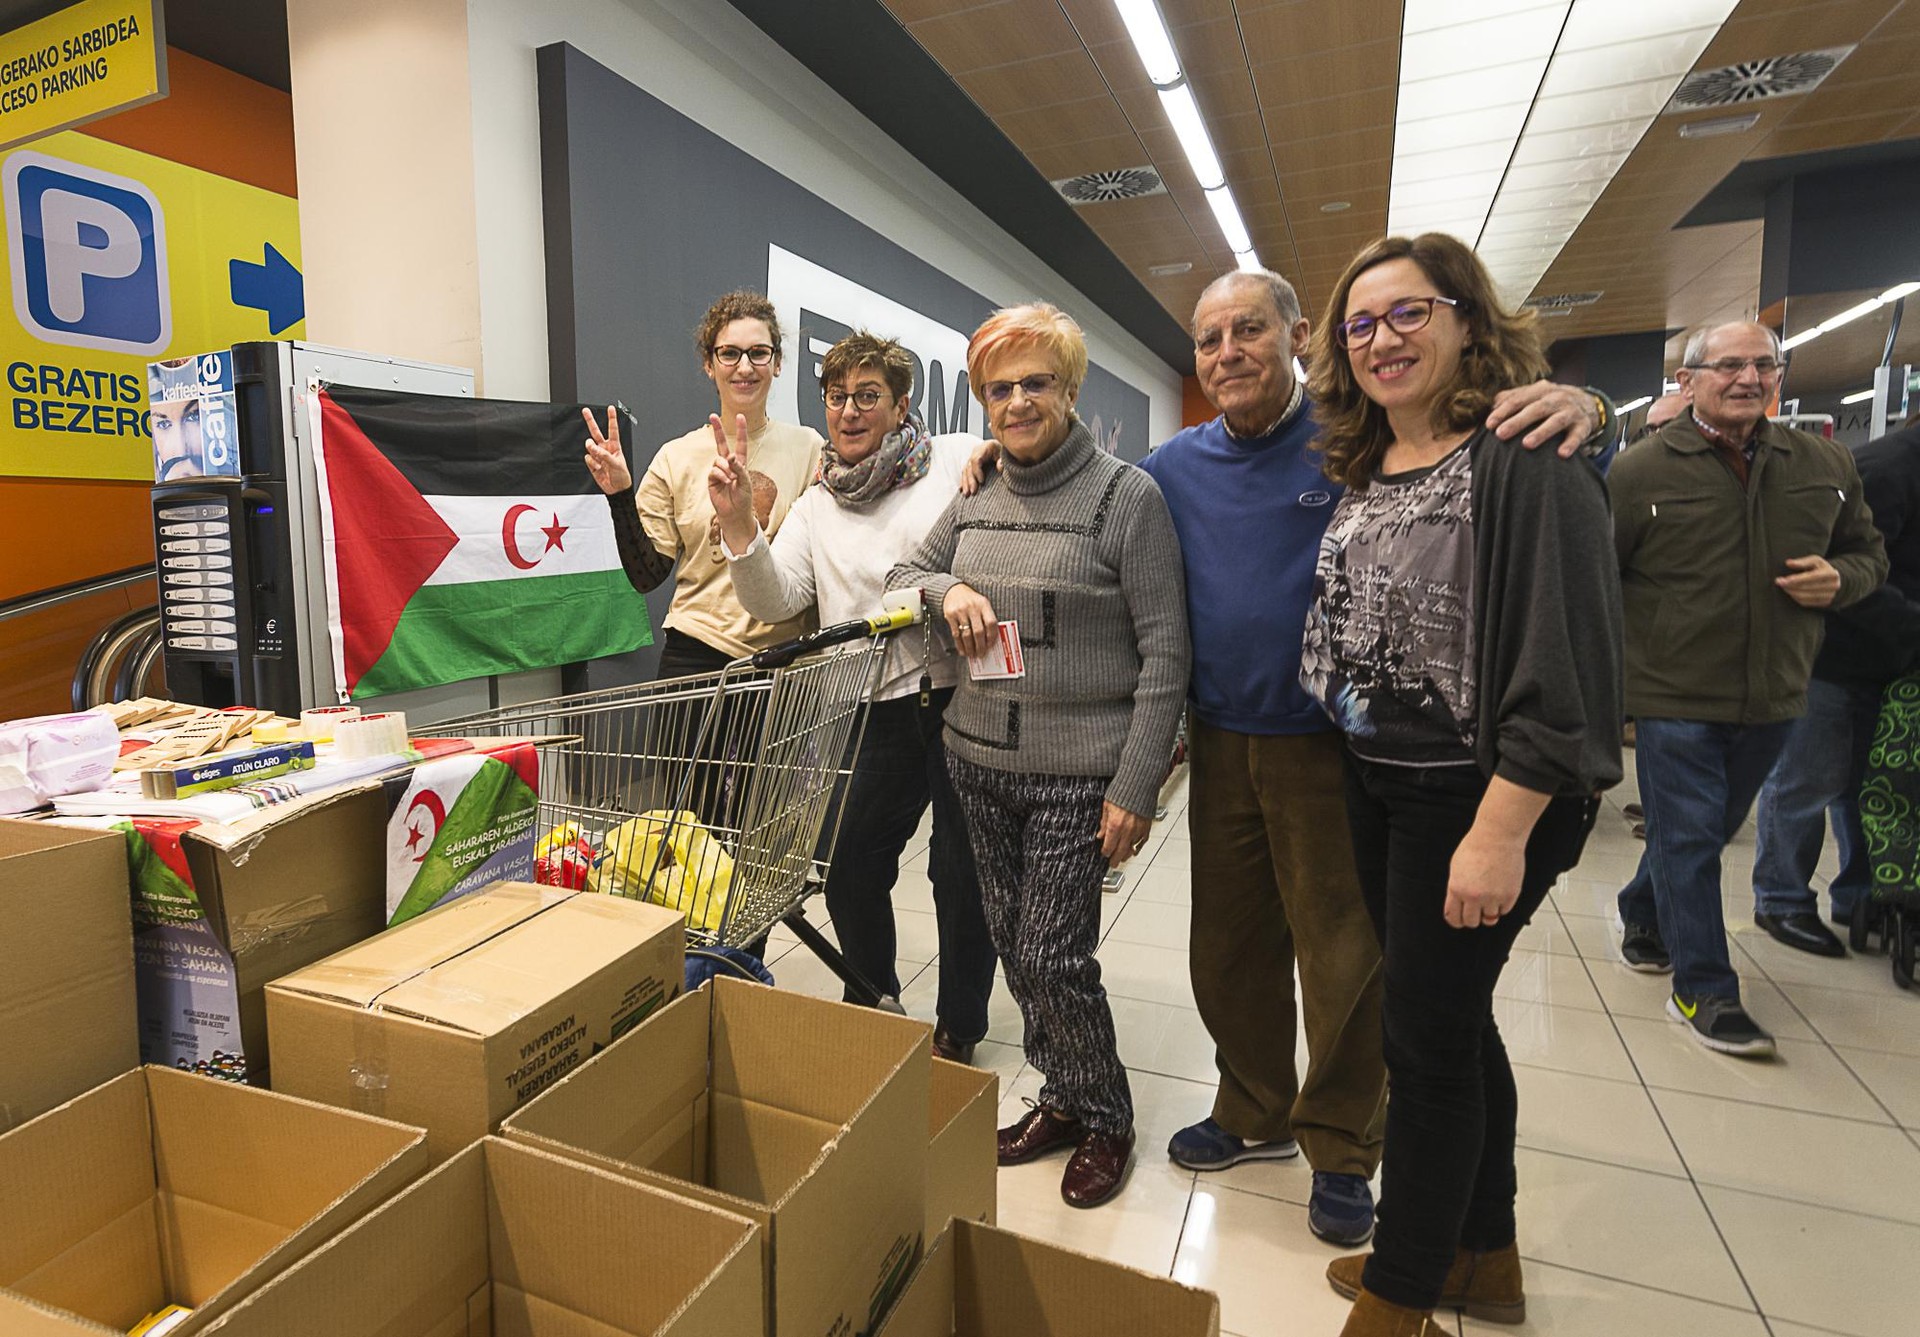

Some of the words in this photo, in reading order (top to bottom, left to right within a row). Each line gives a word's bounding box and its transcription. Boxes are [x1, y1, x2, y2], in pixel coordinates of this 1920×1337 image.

[0, 45, 59, 87] GERAKO
[62, 15, 140, 62] SARBIDEA
[0, 82, 38, 115] CESO
[41, 57, 108, 99] PARKING
[40, 188, 143, 323] P
[7, 362, 141, 402] GRATIS
[162, 382, 198, 401] kaffee
[201, 768, 221, 780] eliges
[232, 761, 253, 774] ATÚN
[254, 756, 280, 769] CLARO
[445, 827, 501, 857] SAHARAREN
[503, 816, 534, 836] ALDEKO
[453, 847, 487, 868] EUSKAL
[489, 830, 533, 854] KARABANA
[454, 866, 501, 893] CARAVANA
[503, 854, 530, 872] VASCA
[157, 905, 199, 920] ALDEKO
[181, 958, 228, 975] SAHARA
[183, 943, 223, 959] VASCA
[519, 1013, 576, 1060] KARABANA
[549, 1022, 588, 1060] ALDEKO
[504, 1053, 548, 1089] EUSKAL
[516, 1048, 580, 1102] SAHARAREN
